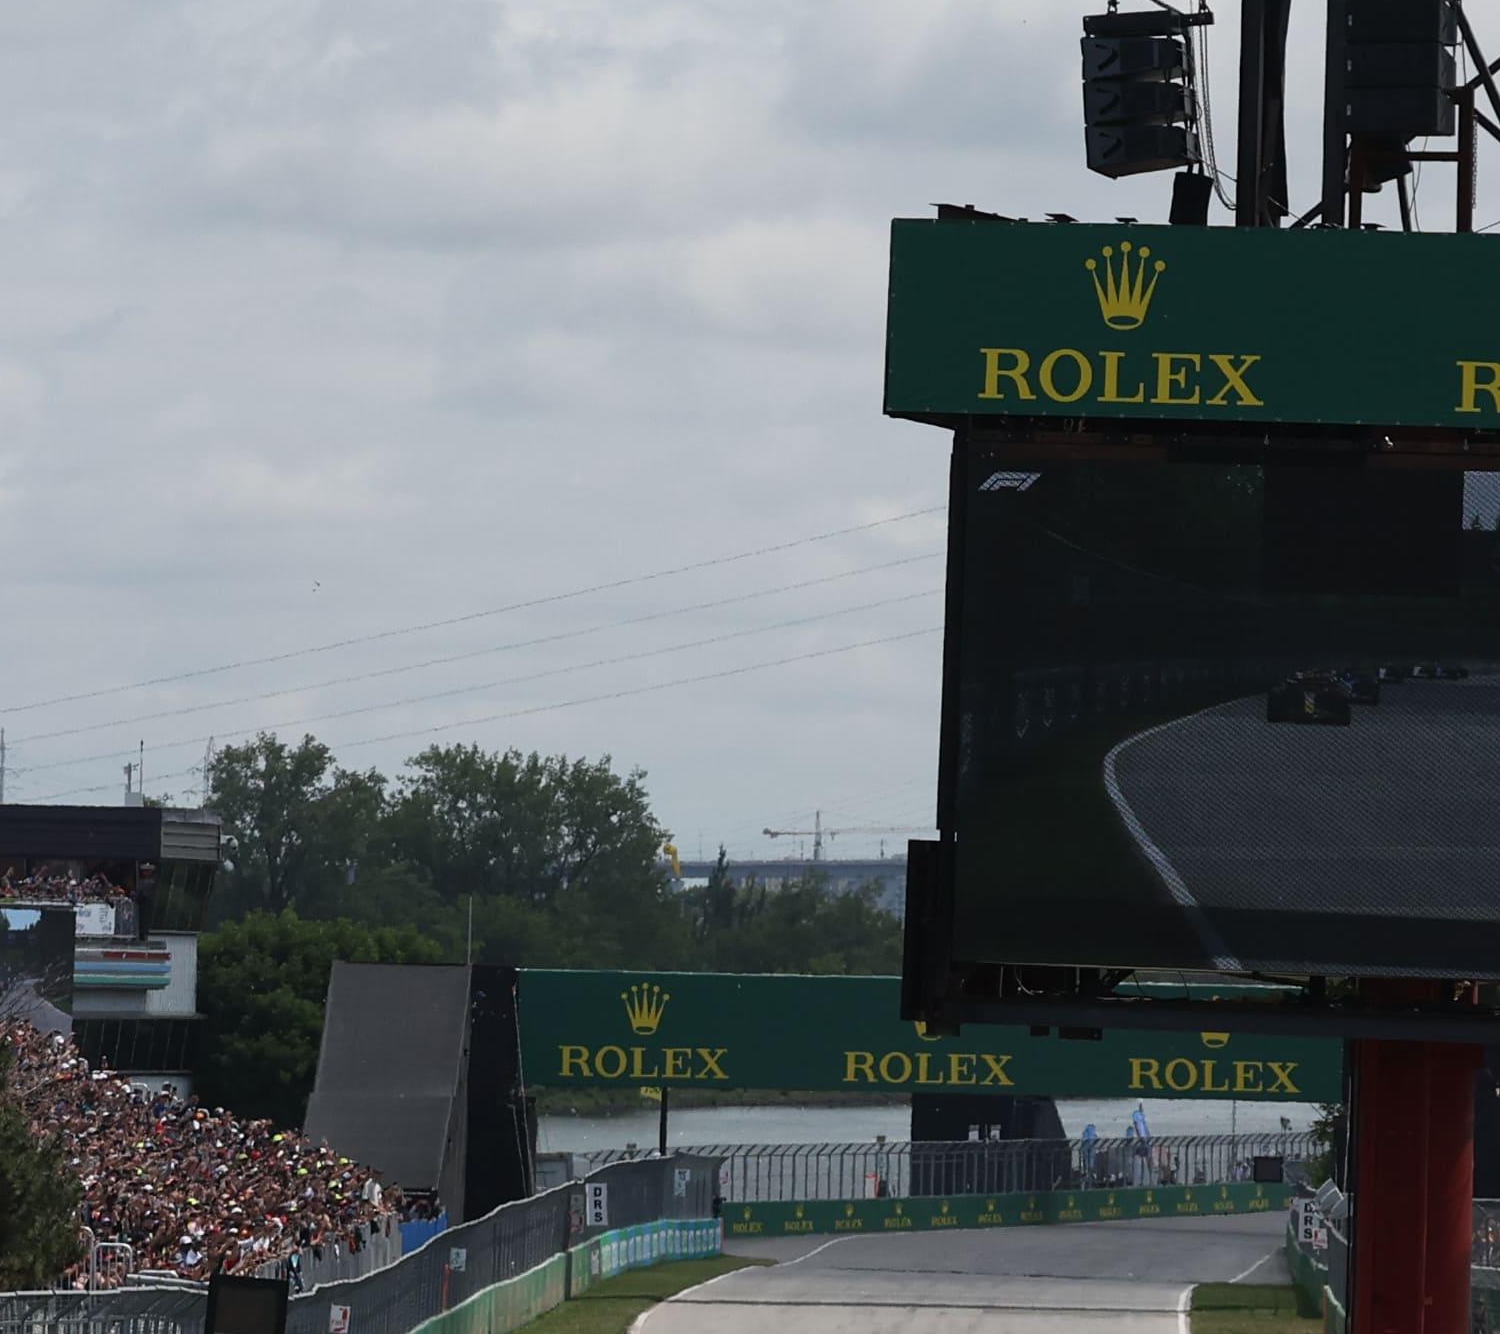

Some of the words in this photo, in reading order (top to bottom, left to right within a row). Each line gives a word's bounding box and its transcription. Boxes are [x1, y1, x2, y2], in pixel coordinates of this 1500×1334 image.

[981, 348, 1262, 406] ROLEX
[561, 1045, 727, 1079] ROLEX
[845, 1051, 1013, 1086] ROLEX
[1130, 1058, 1299, 1094] ROLEX
[592, 1186, 604, 1223] DRS
